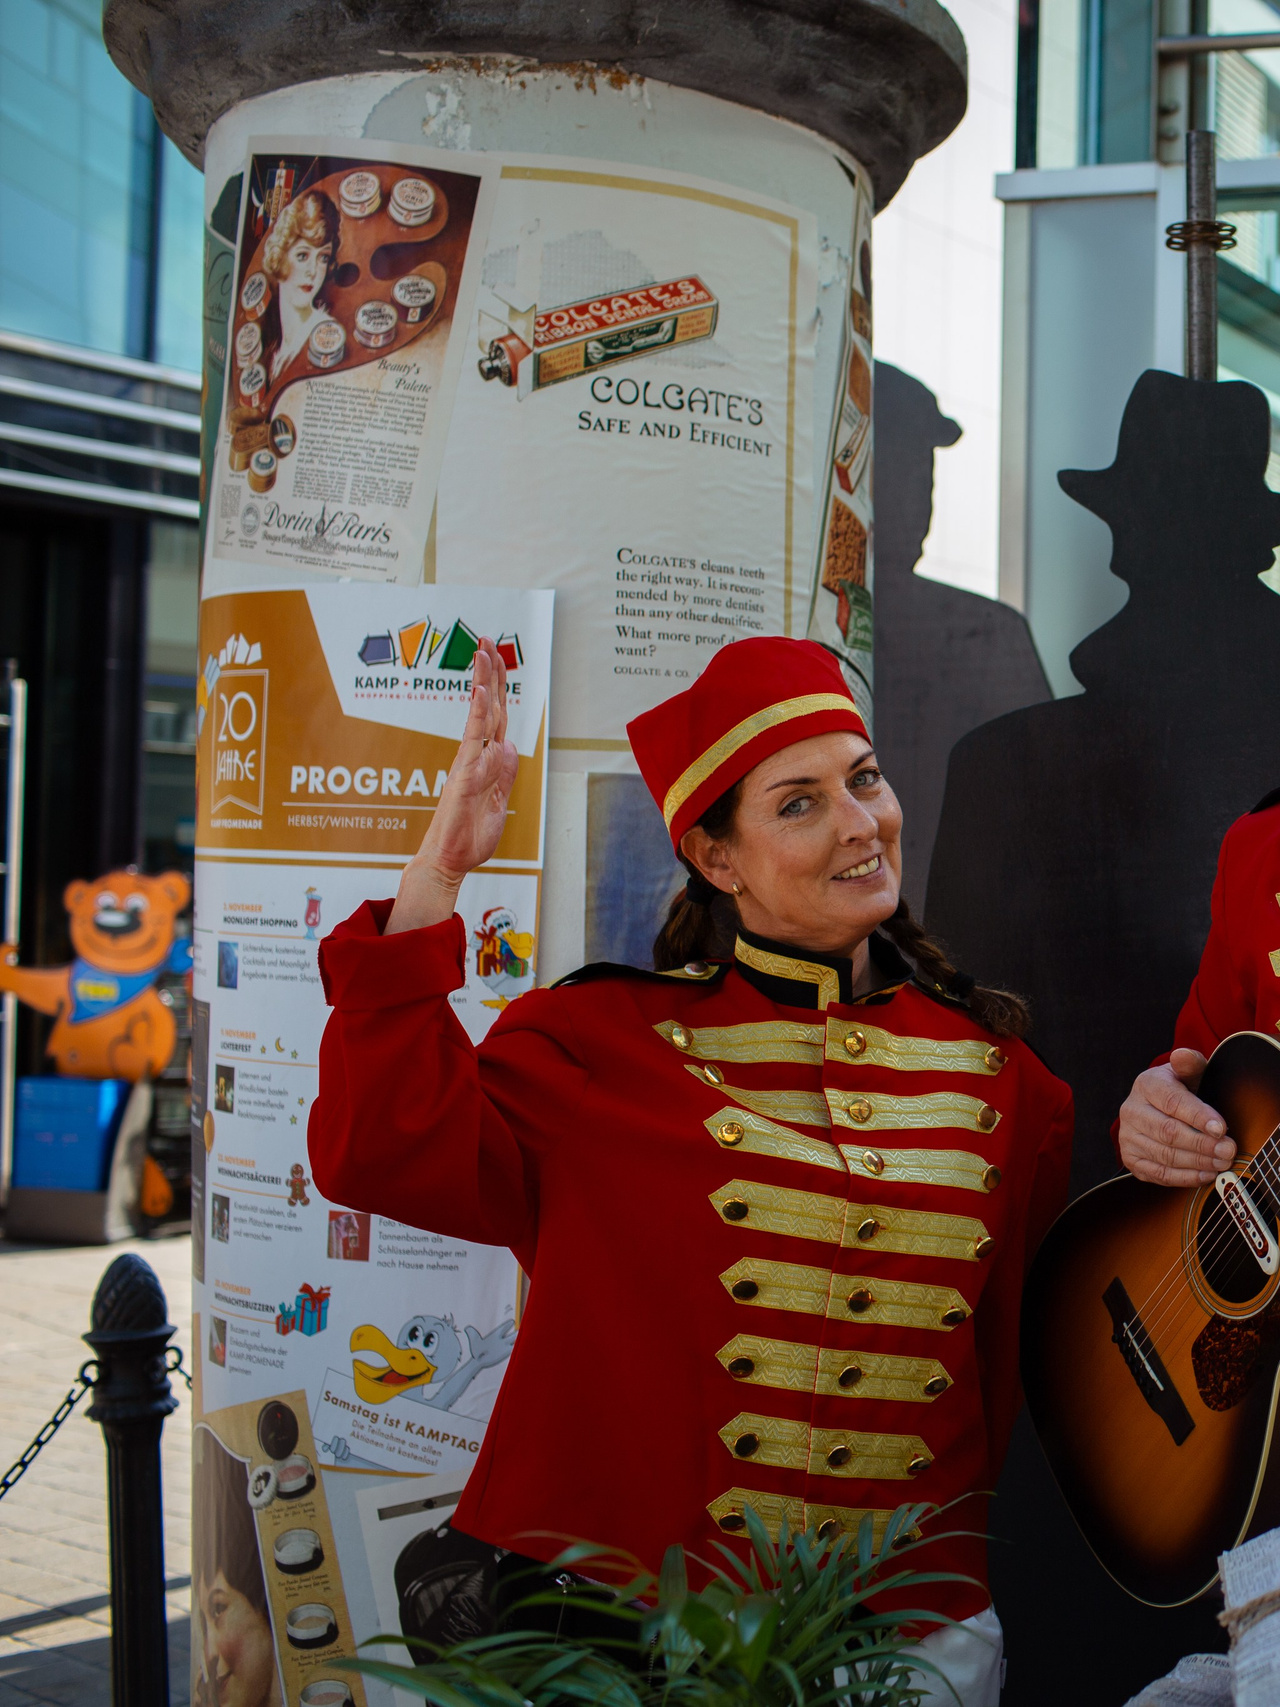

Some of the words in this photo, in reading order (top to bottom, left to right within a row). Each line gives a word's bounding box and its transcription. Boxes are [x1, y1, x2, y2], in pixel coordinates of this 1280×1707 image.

[534, 279, 697, 333] COLGATE'S
[535, 318, 598, 344] RIBBON
[604, 302, 661, 325] DENTAL
[662, 291, 709, 309] CREAM
[590, 375, 764, 427] COLGATE'S
[578, 410, 631, 435] SAFE
[640, 421, 681, 440] AND
[689, 422, 772, 458] EFFICIENT
[262, 501, 313, 533] Dorin
[332, 512, 393, 545] Paris
[616, 547, 697, 570] COLGATE'S
[700, 559, 735, 575] cleans
[739, 565, 765, 581] teeth
[616, 568, 638, 583] the
[640, 570, 672, 586] right
[674, 576, 703, 591] way.
[707, 576, 716, 590] It
[719, 578, 728, 591] is
[616, 589, 668, 602] mended
[673, 589, 689, 604] by
[693, 594, 722, 607] more
[725, 597, 765, 613] dentists
[615, 603, 645, 618] than
[648, 608, 673, 622] any
[675, 608, 709, 623] other
[711, 612, 765, 631] dentifrice.
[615, 624, 652, 640] What
[657, 629, 691, 643] more
[694, 634, 727, 647] proof
[614, 644, 657, 658] want?
[613, 665, 662, 677] COLGATE
[664, 668, 672, 678] &
[674, 668, 691, 679] CO.
[355, 676, 400, 690] KAMP
[413, 678, 522, 695] PROMEDE
[217, 691, 257, 743] 20
[214, 750, 256, 787] JAHRE
[287, 814, 374, 830] HERBST/WINTER
[377, 817, 408, 831] 2024
[223, 915, 259, 926] MOONLIGHT
[259, 917, 299, 929] SHOPPING
[275, 945, 306, 956] kostenlose
[242, 956, 266, 967] Cocktails
[267, 959, 278, 967] und
[279, 960, 311, 973] Moonlight
[242, 969, 268, 981] Angebote
[275, 974, 298, 982] unseren
[299, 974, 319, 984] Shops
[261, 1073, 272, 1082] und
[268, 1087, 289, 1096] basteln
[218, 1167, 282, 1186] WEIHNACHTSBÄCKEREI
[287, 1211, 297, 1219] die
[379, 1218, 396, 1228] Foto
[275, 1224, 303, 1233] verzieren
[378, 1231, 429, 1244] Tannenbaum
[431, 1234, 444, 1244] als
[377, 1245, 453, 1259] Schlüsselanhänger
[454, 1249, 468, 1258] mit
[377, 1259, 397, 1269] nach
[398, 1260, 425, 1271] Hause
[426, 1262, 459, 1272] nehmen
[215, 1292, 276, 1314] WEIHNACHTSBUZZERN
[250, 1329, 261, 1338] und
[277, 1348, 288, 1356] der
[323, 1390, 380, 1425] Samstag
[383, 1412, 402, 1429] ist
[405, 1420, 481, 1454] KAMPTAG
[351, 1419, 365, 1431] Die
[367, 1423, 407, 1447] Teilnahme
[408, 1440, 420, 1451] an
[421, 1443, 443, 1458] allen
[350, 1430, 385, 1450] Aktionen
[386, 1442, 396, 1454] ist
[398, 1444, 439, 1468] kostenlos!
[1203, 1656, 1230, 1669] Press
